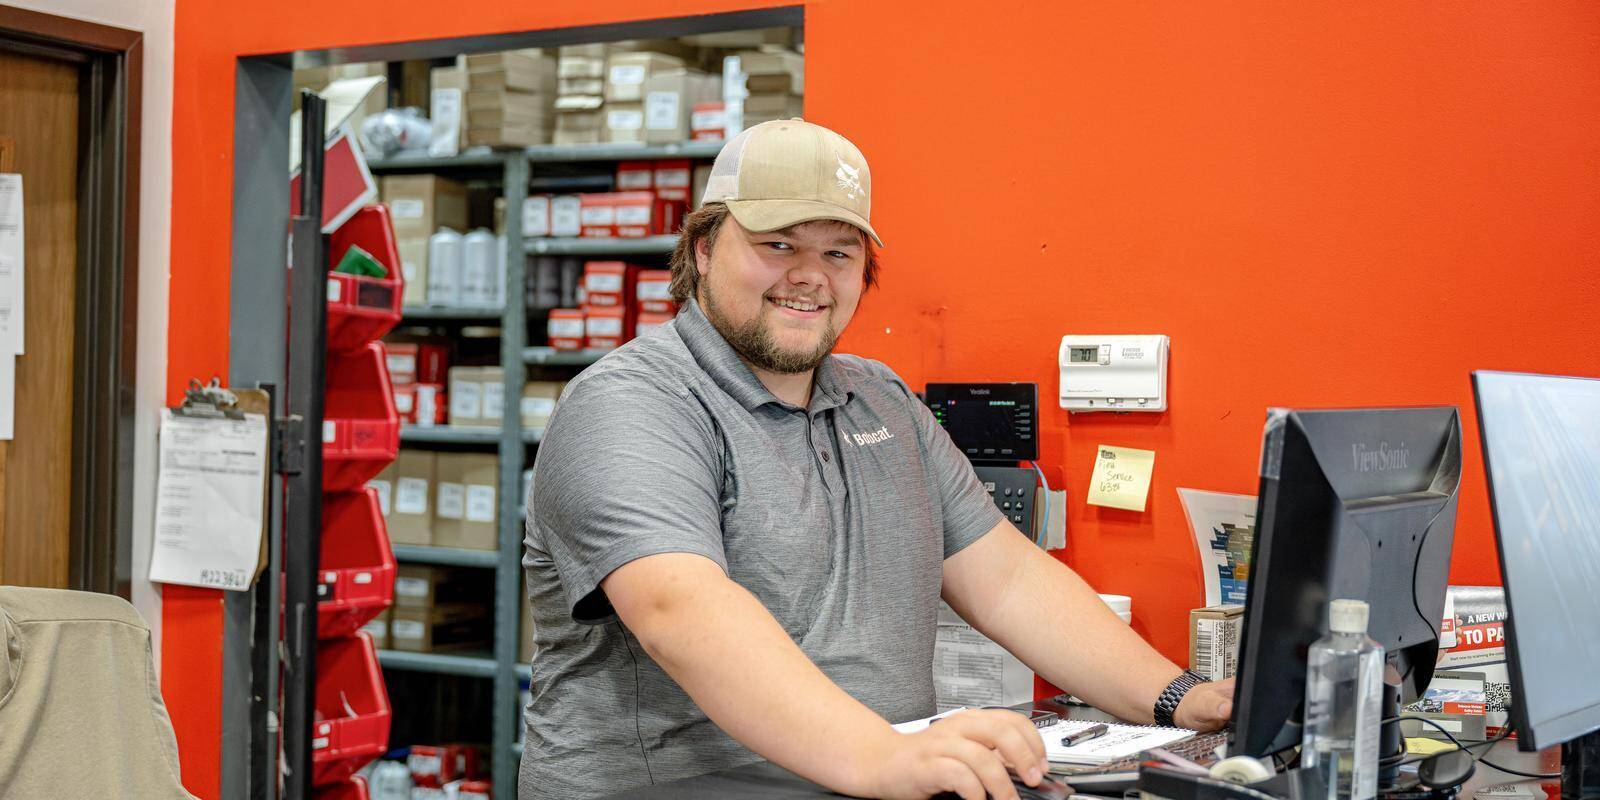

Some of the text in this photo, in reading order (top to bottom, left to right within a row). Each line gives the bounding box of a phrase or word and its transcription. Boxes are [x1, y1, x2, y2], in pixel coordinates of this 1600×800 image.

[1352, 441, 1409, 472] ViewSonic
[1467, 615, 1474, 623] A
[1476, 612, 1496, 622] NEW
[1463, 630, 1483, 645] TO
